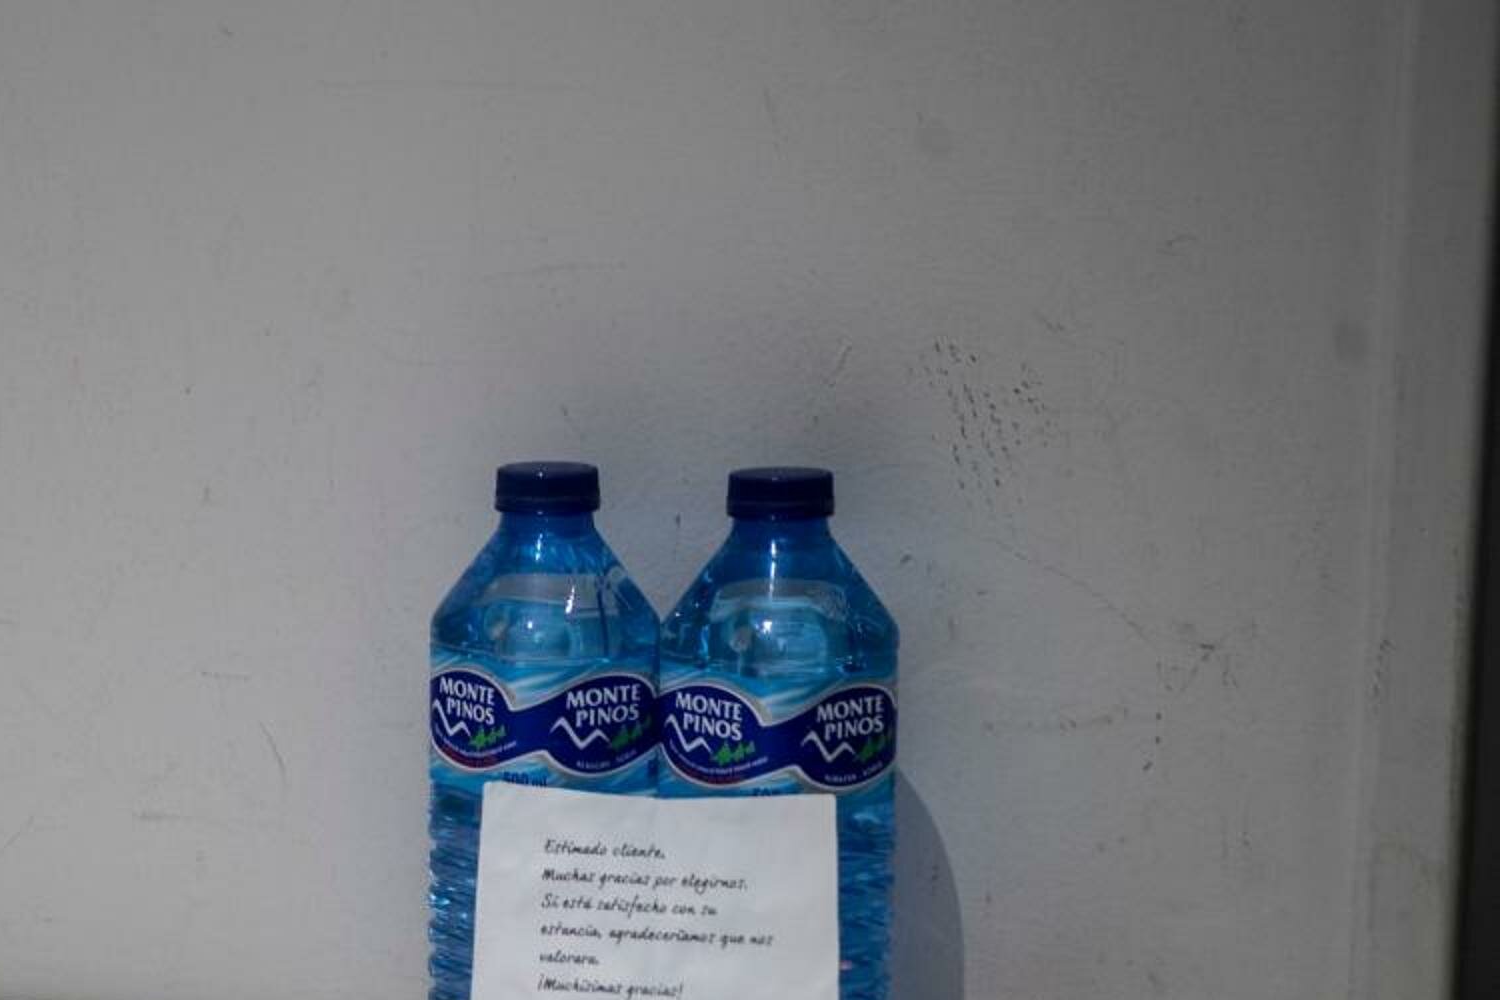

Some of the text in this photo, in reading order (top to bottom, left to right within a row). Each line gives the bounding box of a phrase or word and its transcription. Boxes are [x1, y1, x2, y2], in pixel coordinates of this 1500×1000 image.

[439, 677, 495, 706] MONTE
[566, 683, 641, 710] MONTE
[446, 699, 495, 725] PINOS
[575, 704, 639, 728] PINOS
[675, 692, 743, 721] MONTE
[816, 694, 885, 723] MONTE
[683, 713, 742, 741] PINOS
[825, 715, 885, 742] PINOS
[544, 839, 607, 856] Estimado
[541, 868, 596, 883] Muchas
[598, 872, 650, 890] gracias
[651, 876, 677, 890] por
[596, 894, 667, 919] satisfecho
[671, 904, 696, 915] con
[700, 904, 719, 916] su
[719, 934, 745, 949] que
[749, 934, 774, 946] nos
[625, 980, 683, 1000] gracias!
